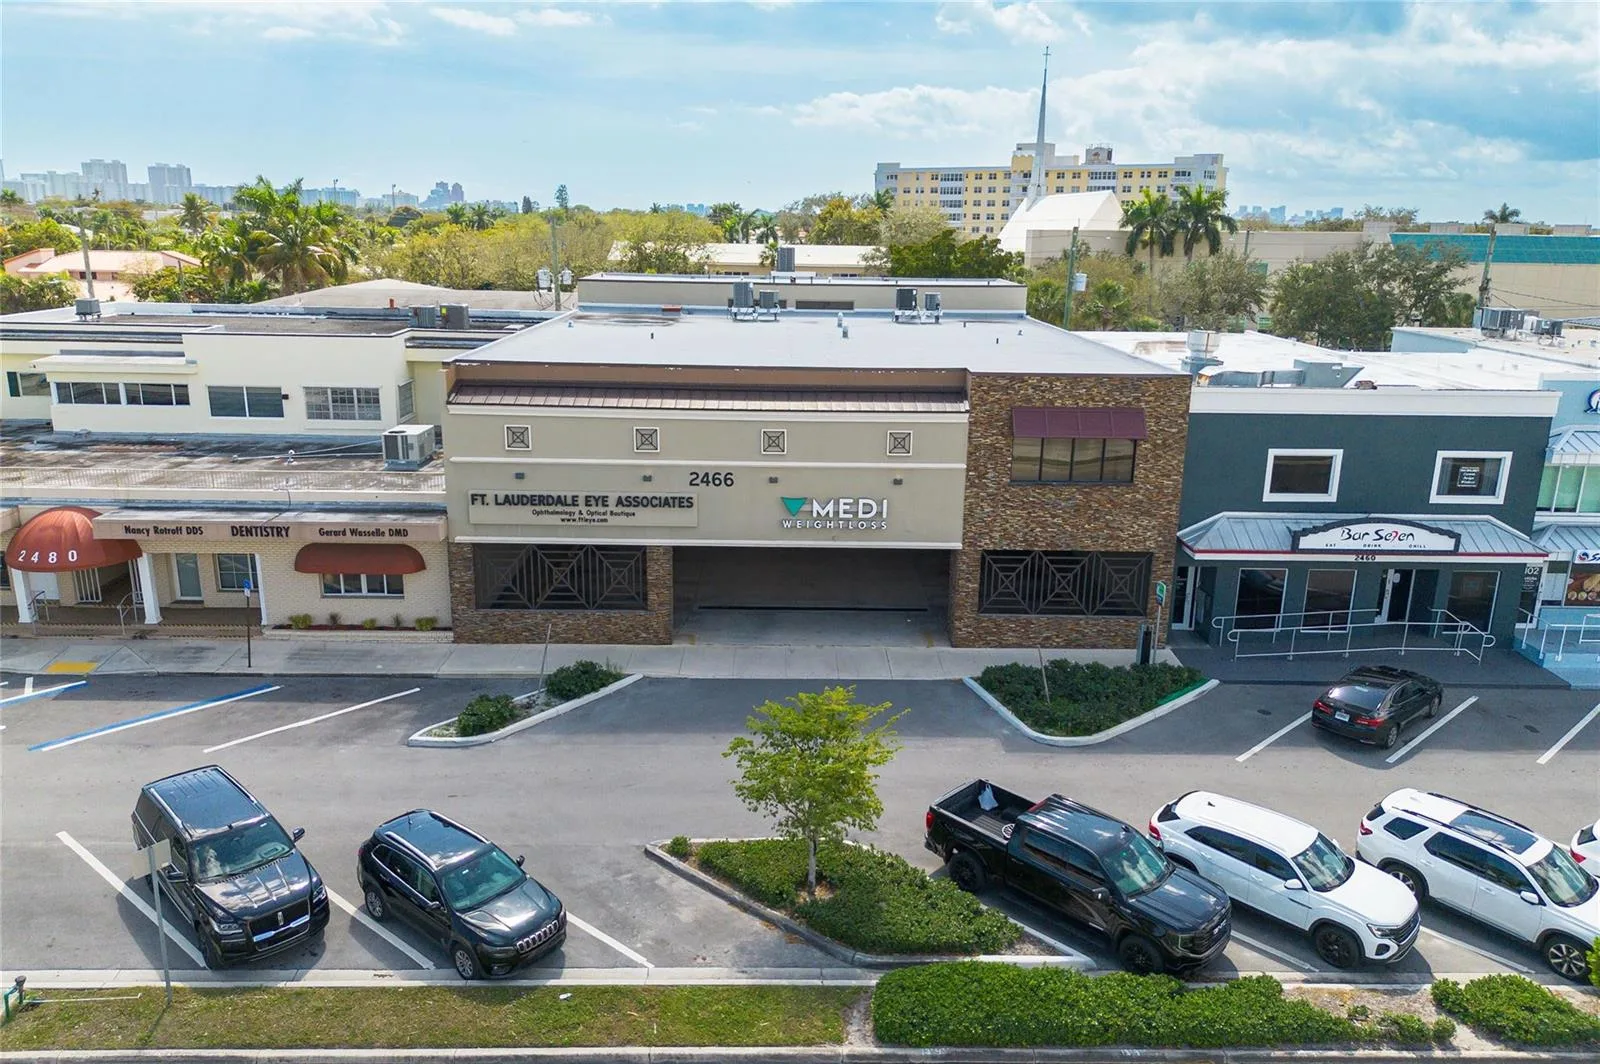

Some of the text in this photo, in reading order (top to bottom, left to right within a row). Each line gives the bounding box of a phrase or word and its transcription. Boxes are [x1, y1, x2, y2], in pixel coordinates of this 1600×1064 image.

[689, 472, 734, 487] 2466
[470, 493, 694, 509] FT. LAUDERDALE EYE ASSOCIATES
[532, 509, 576, 517] Ophthalmology
[586, 509, 608, 517] Optical
[609, 510, 636, 518] Boutique
[812, 498, 888, 519] MEDI
[782, 519, 888, 530] WEIGHTLOSS
[124, 525, 204, 537] Nancy Rotroff DDS
[231, 525, 290, 538] DENTISTRY
[318, 527, 409, 537] Gerard Wasselle DMD
[1340, 527, 1370, 541] Bar
[17, 549, 77, 564] 2480
[1354, 554, 1377, 562] 2460
[1524, 567, 1540, 575] 102
